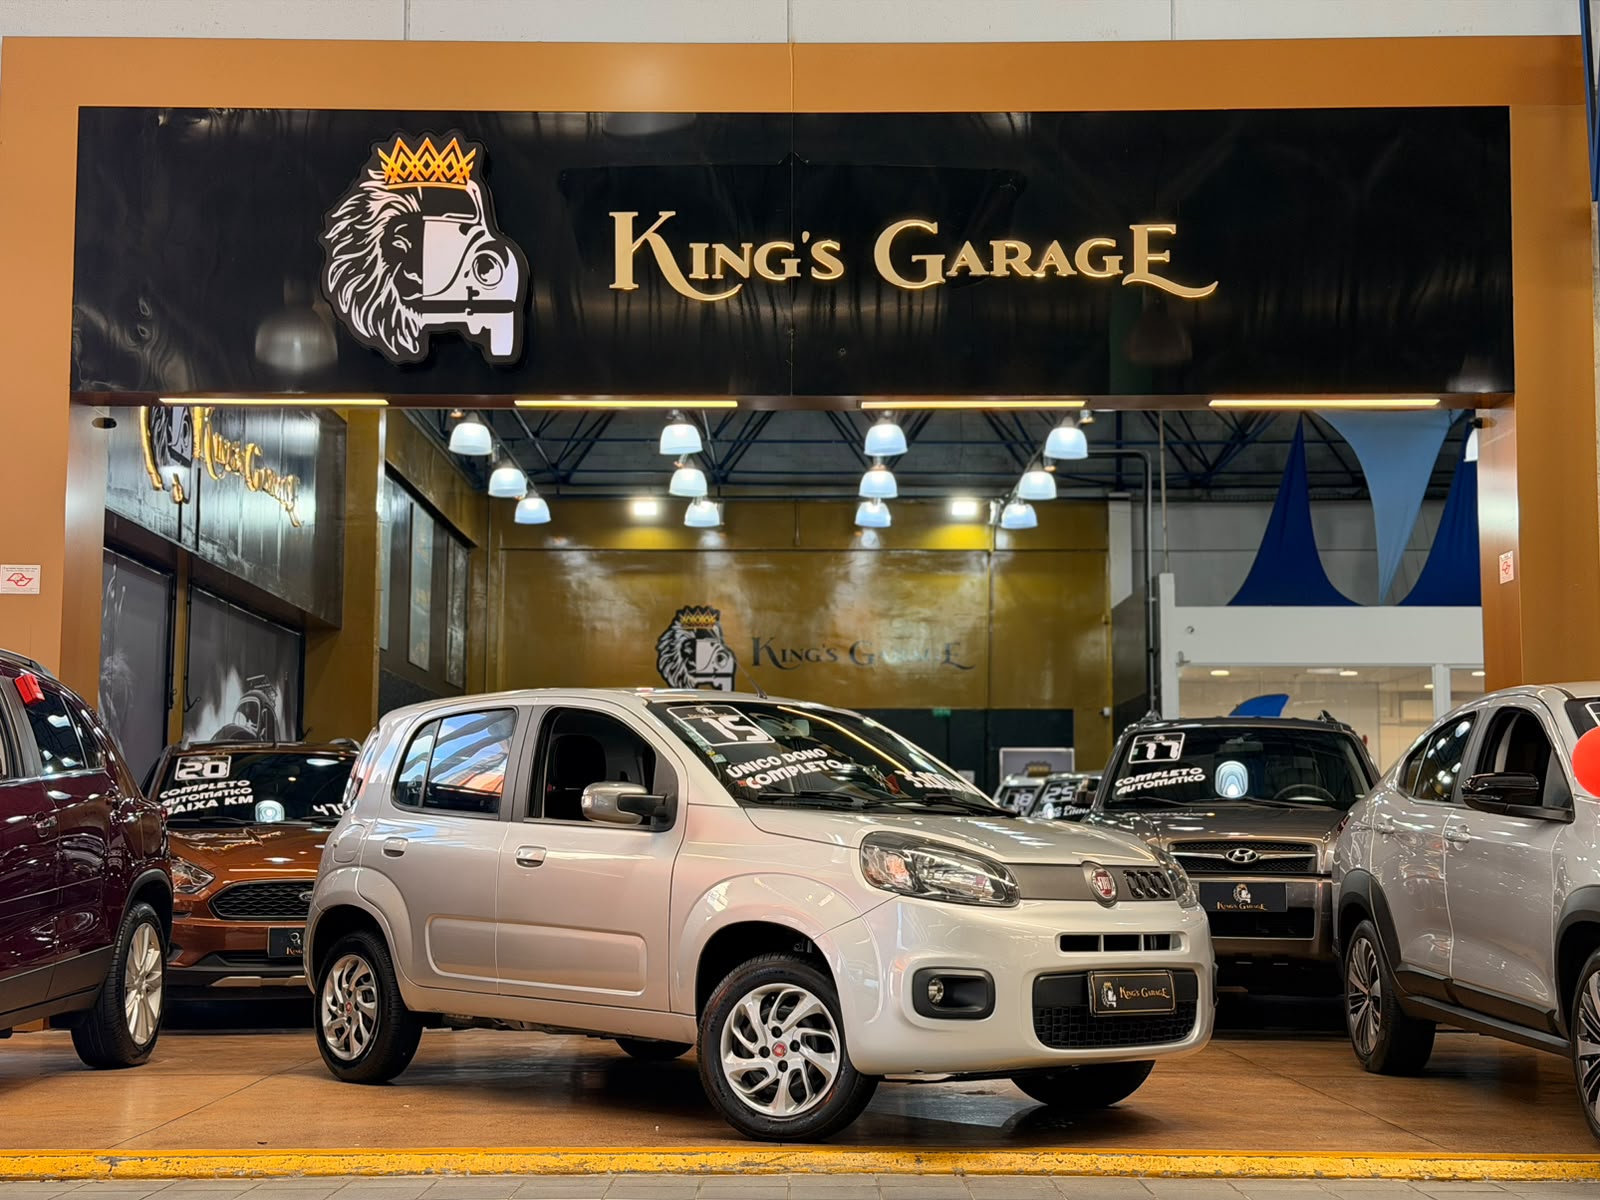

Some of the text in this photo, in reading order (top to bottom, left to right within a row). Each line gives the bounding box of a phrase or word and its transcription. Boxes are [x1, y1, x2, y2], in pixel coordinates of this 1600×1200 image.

[608, 210, 1219, 302] KING'S GARAGE
[701, 714, 770, 742] 15
[177, 761, 228, 779] 20
[725, 747, 829, 779] ÚNICO DONO
[745, 758, 844, 790] COMPLETO
[159, 779, 251, 799] COMPLETO
[1114, 766, 1203, 788] COMPLETO
[224, 794, 254, 806] KM
